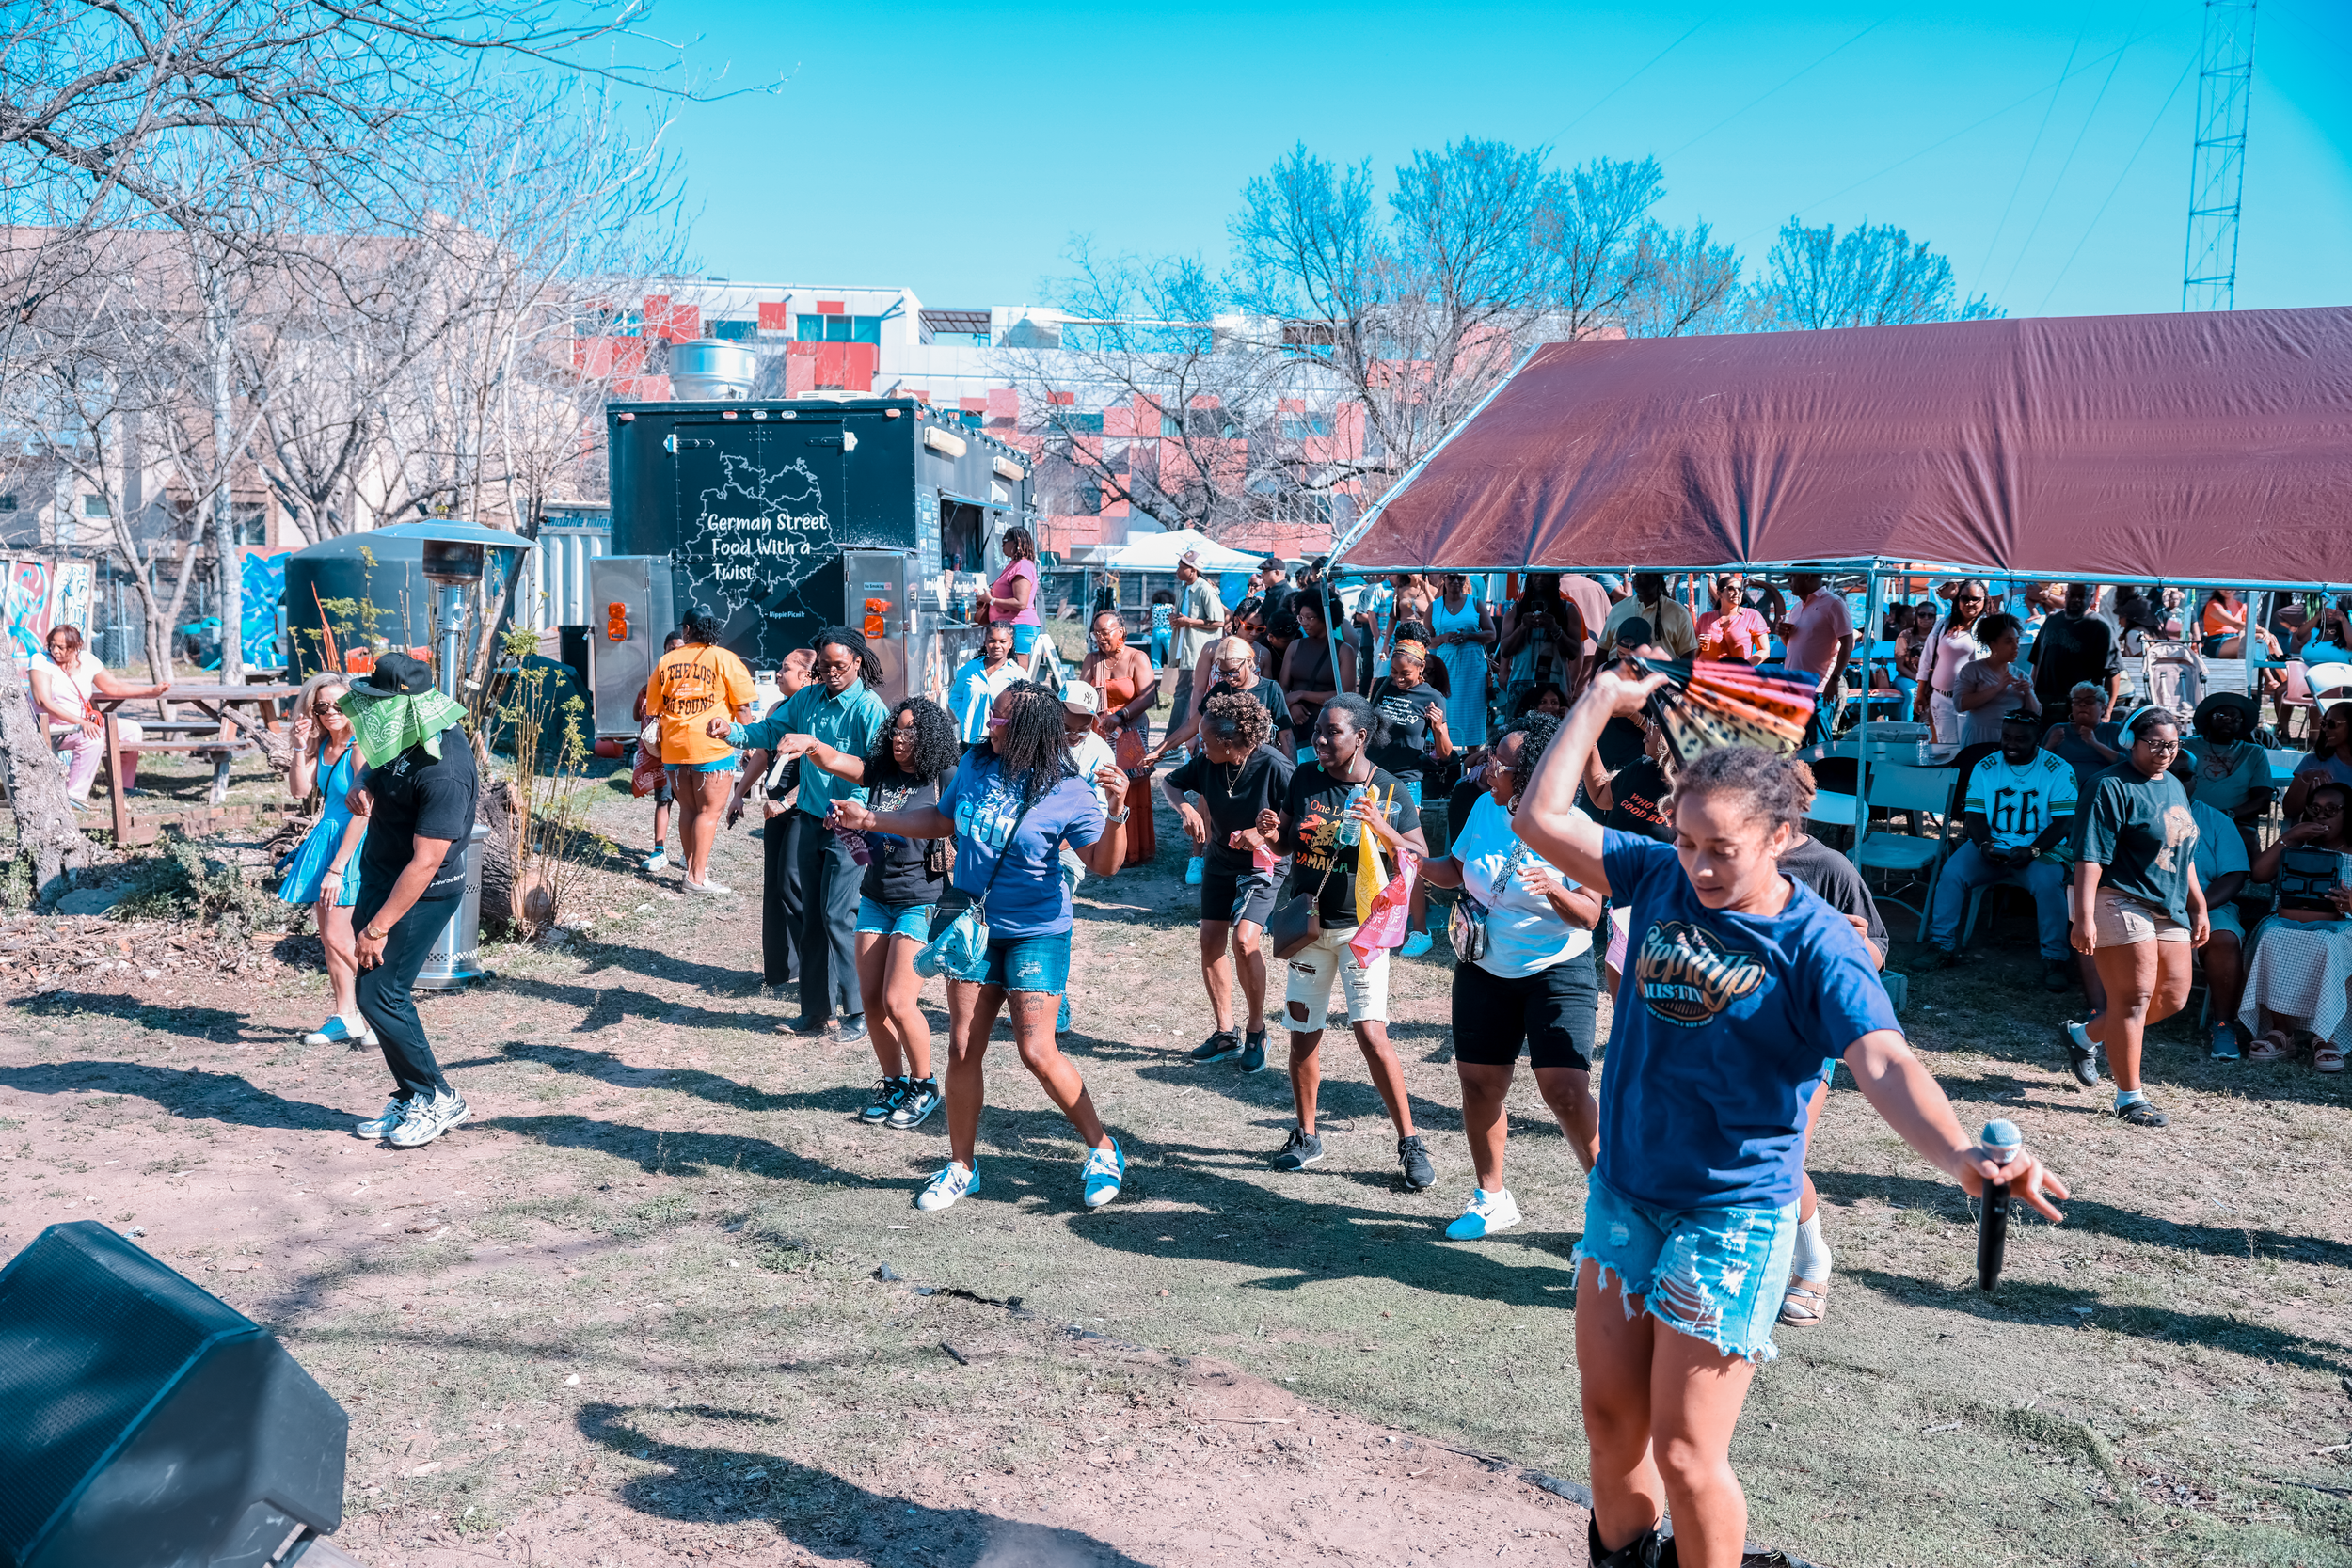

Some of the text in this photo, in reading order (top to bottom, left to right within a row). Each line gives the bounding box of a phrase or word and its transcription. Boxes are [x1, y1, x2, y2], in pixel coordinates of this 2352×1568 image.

[545, 511, 584, 527] mobile
[776, 513, 828, 530] Street
[711, 537, 811, 556] Food With a
[769, 611, 787, 620] Hippie
[668, 662, 691, 681] THE
[693, 662, 716, 690] LOST
[677, 693, 715, 715] FOUND
[1311, 800, 1331, 815] One
[1620, 800, 1647, 818] GOOD
[1992, 785, 2040, 837] 66
[1644, 983, 1704, 1004] AUSTIN
